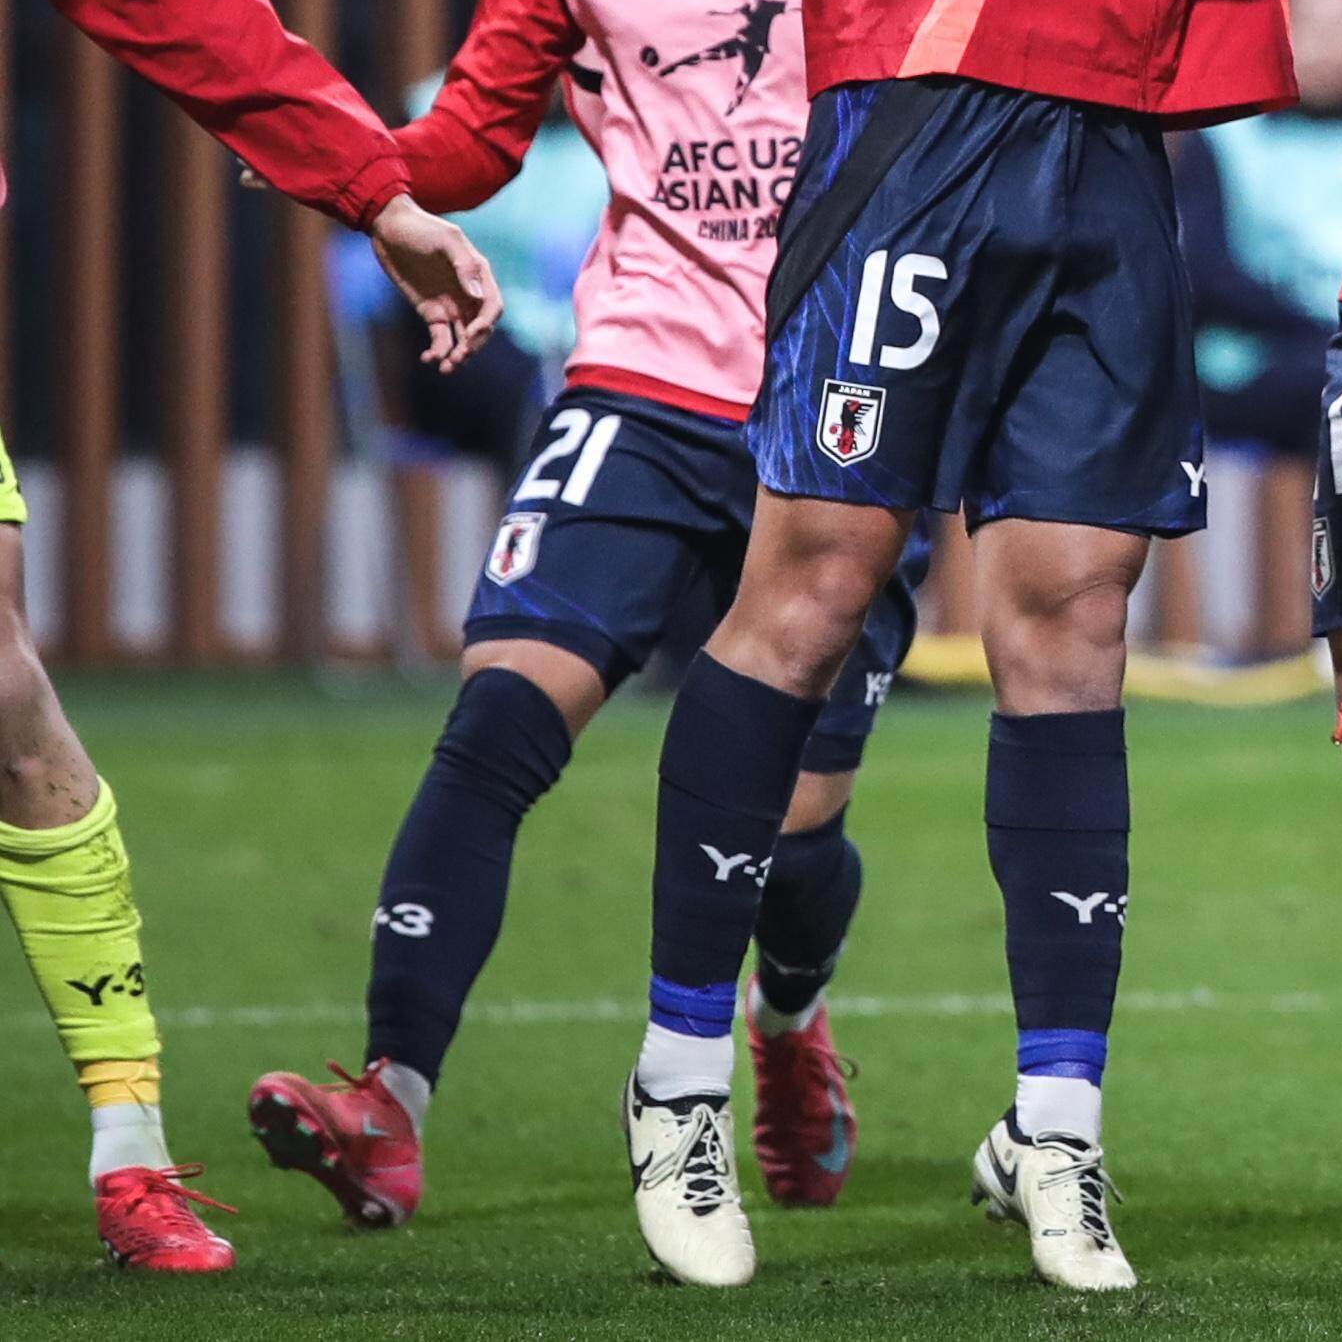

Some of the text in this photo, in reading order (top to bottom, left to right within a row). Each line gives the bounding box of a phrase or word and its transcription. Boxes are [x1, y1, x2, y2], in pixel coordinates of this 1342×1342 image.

[662, 140, 738, 174] AFC
[650, 177, 760, 211] ASIAN
[698, 218, 749, 241] CHINA
[848, 249, 948, 371] 15
[838, 385, 871, 398] JAPAN
[512, 407, 622, 507] 21
[63, 961, 145, 1007] Y-3
